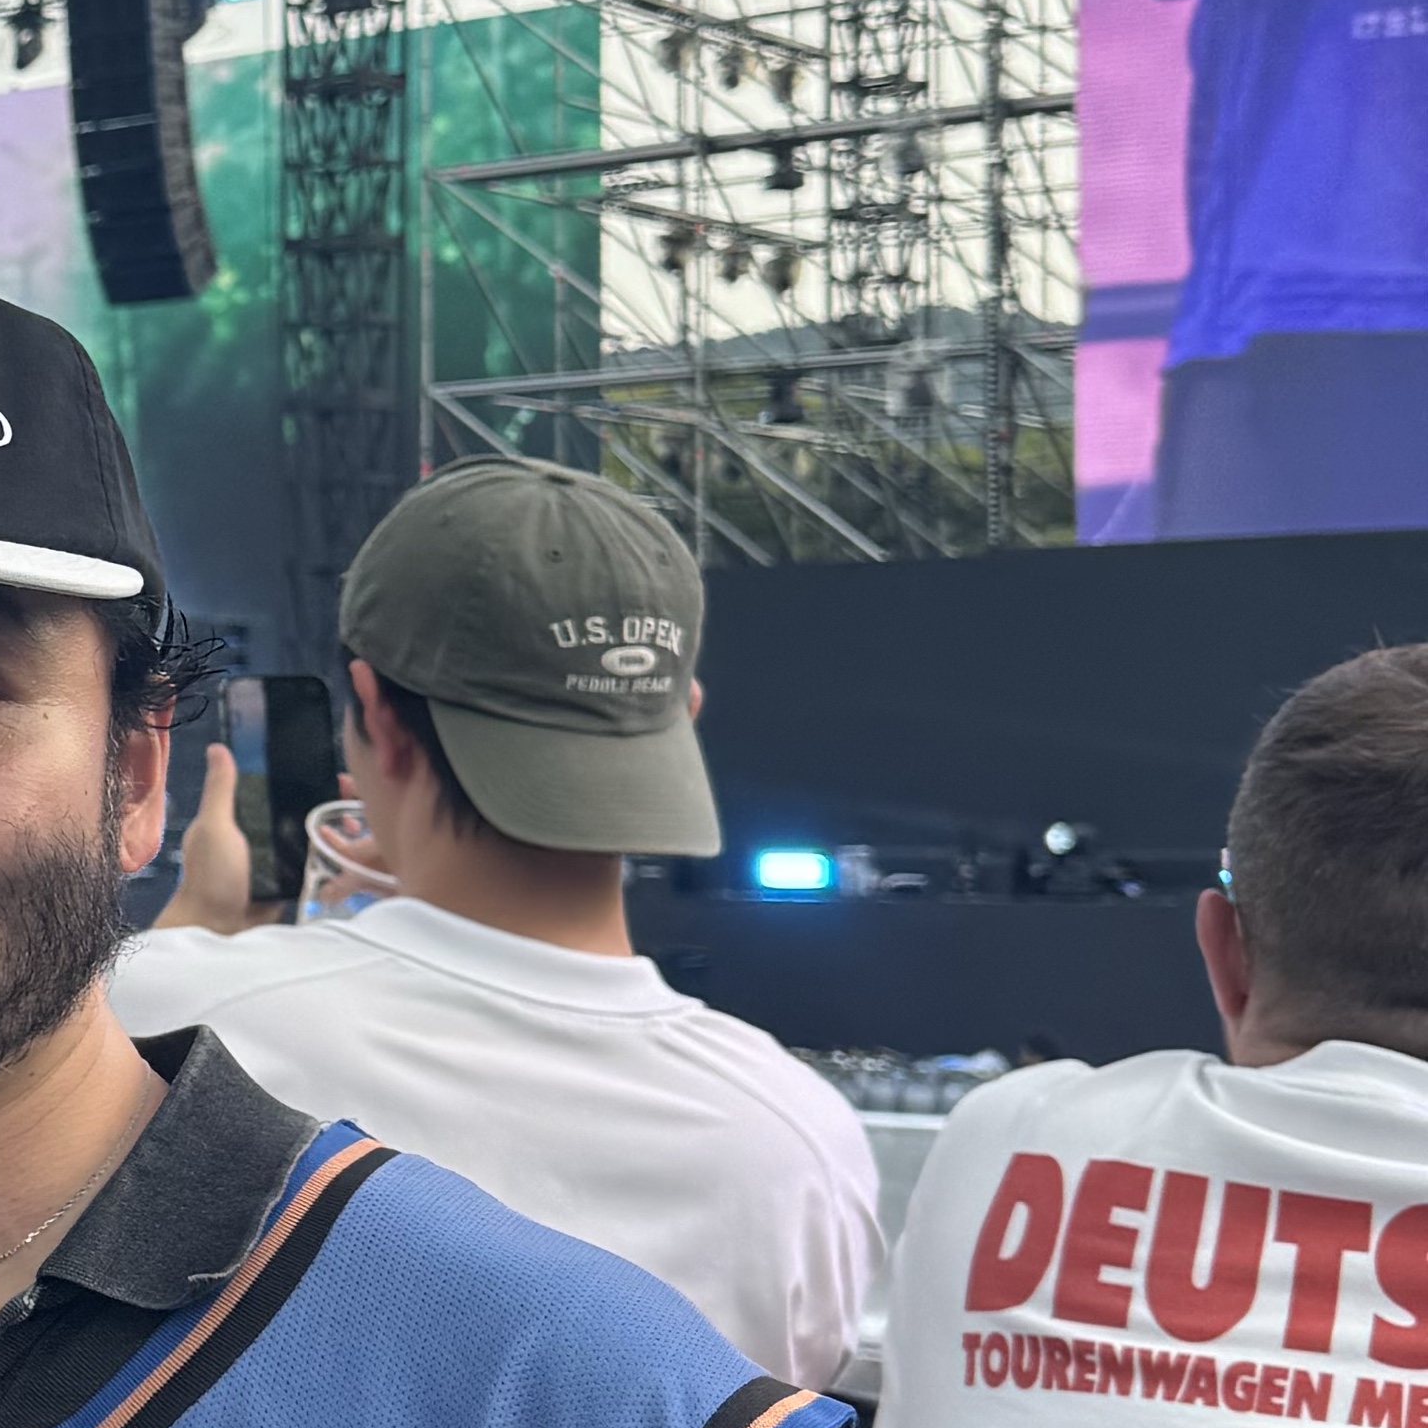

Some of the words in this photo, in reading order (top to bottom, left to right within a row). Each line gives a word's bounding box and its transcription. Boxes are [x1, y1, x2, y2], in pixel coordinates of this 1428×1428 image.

[549, 615, 613, 648] U.S.
[623, 615, 683, 657] OPEN
[962, 1332, 1333, 1423] TOURENWAGEN
